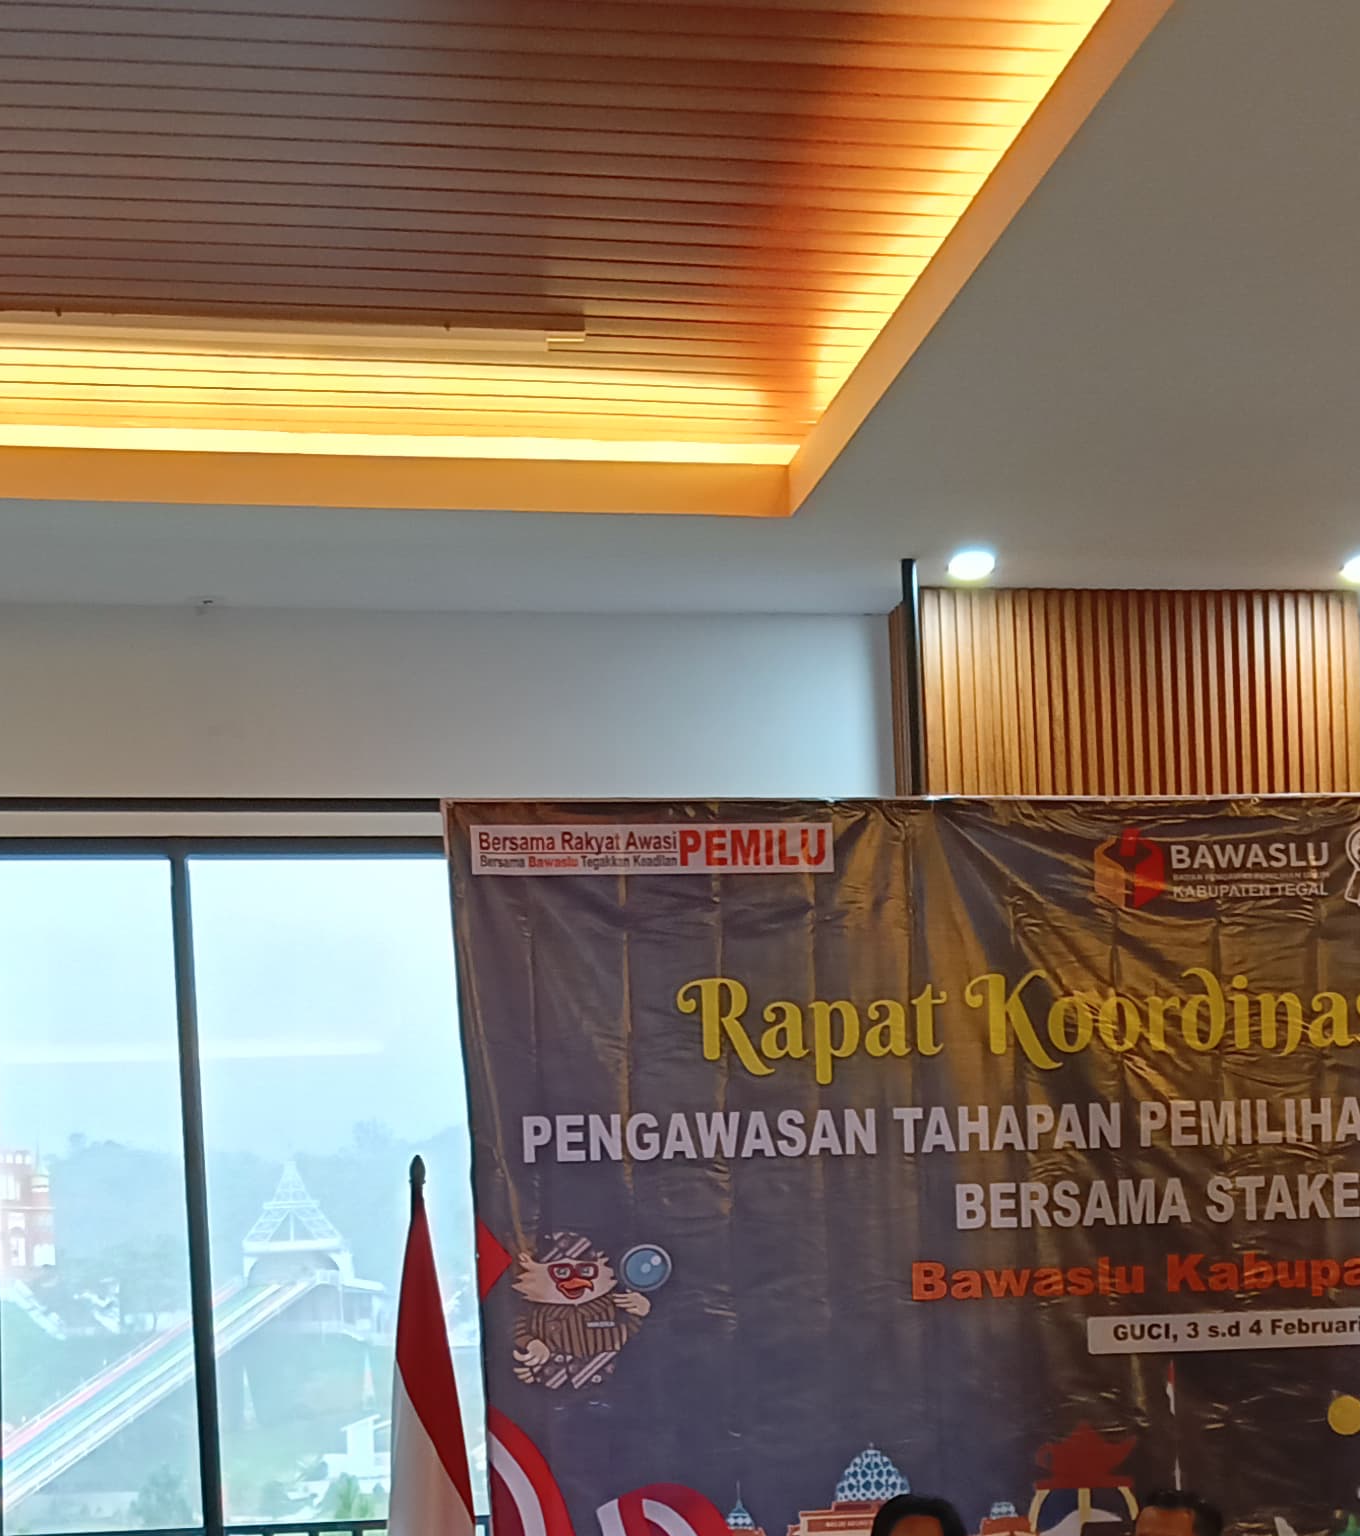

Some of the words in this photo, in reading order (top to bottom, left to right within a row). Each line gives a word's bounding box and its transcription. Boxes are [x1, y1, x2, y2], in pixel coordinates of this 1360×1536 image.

[479, 832, 555, 851] Bersama
[562, 831, 621, 855] Rakyat
[625, 830, 677, 850] Awasi
[679, 828, 826, 867] PEMILU
[480, 855, 526, 868] Bersama
[1169, 841, 1329, 869] BAWASLU
[1172, 883, 1271, 898] KABUPATEN
[1275, 882, 1329, 897] TEGAL
[676, 976, 948, 1084] Rapat
[521, 1108, 877, 1164] PENGAWASAN
[893, 1101, 1121, 1153] TAHAPAN
[954, 1177, 1191, 1231] BERSAMA
[910, 1258, 1143, 1301] Bawaslu
[1112, 1321, 1179, 1344] GUCI,
[1186, 1321, 1200, 1339] 3
[1207, 1319, 1241, 1339] s.d
[1248, 1319, 1263, 1338] 4
